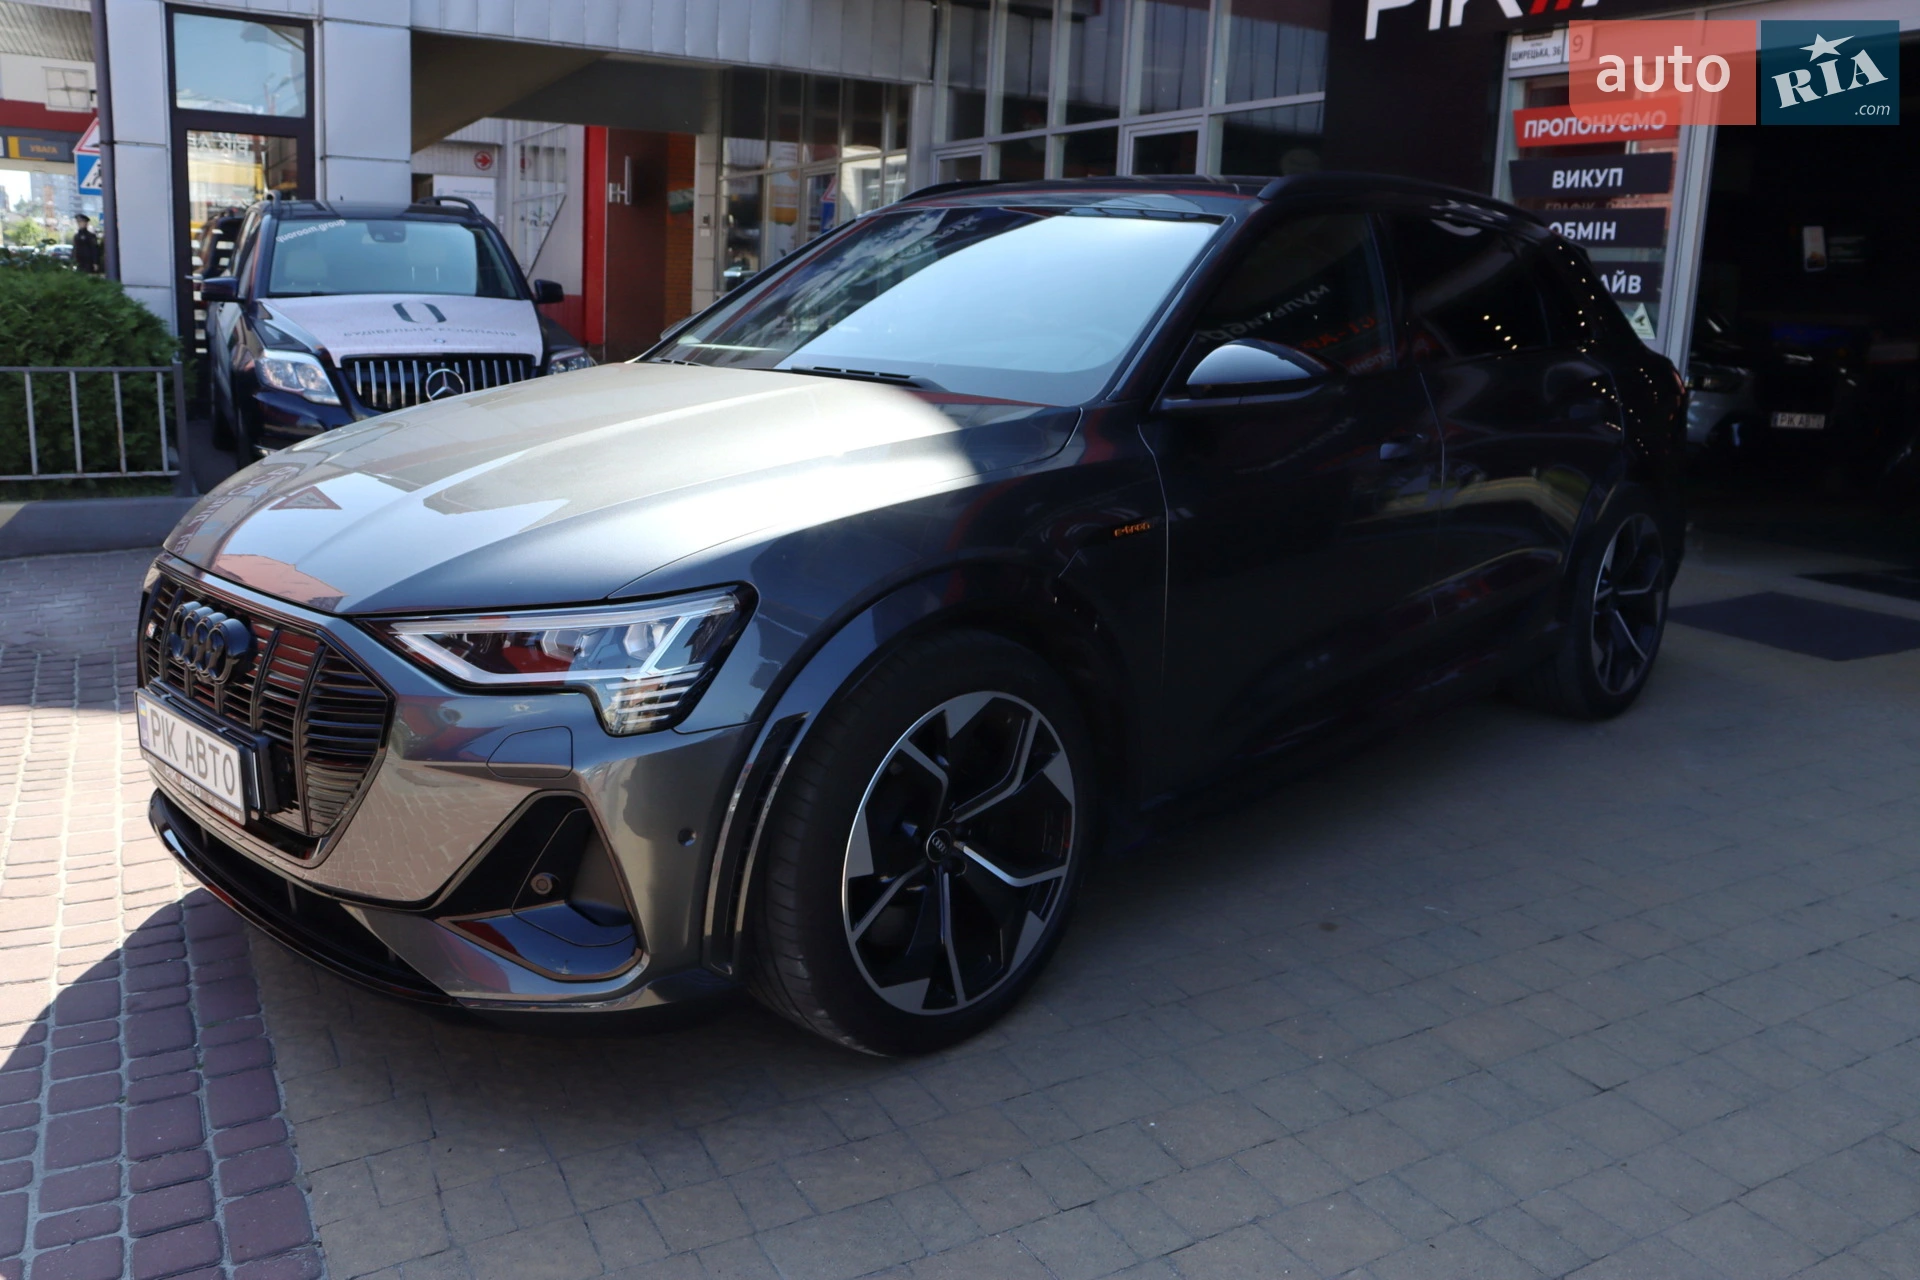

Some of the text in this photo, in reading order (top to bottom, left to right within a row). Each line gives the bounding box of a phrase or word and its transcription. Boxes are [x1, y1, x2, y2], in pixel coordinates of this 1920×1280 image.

[1572, 34, 1584, 53] 9
[1523, 110, 1667, 139] ПРОПОНУЄМО
[1551, 168, 1624, 190] ВИКУП
[1549, 221, 1617, 241] ОБМІН
[185, 730, 236, 797] АВТО
